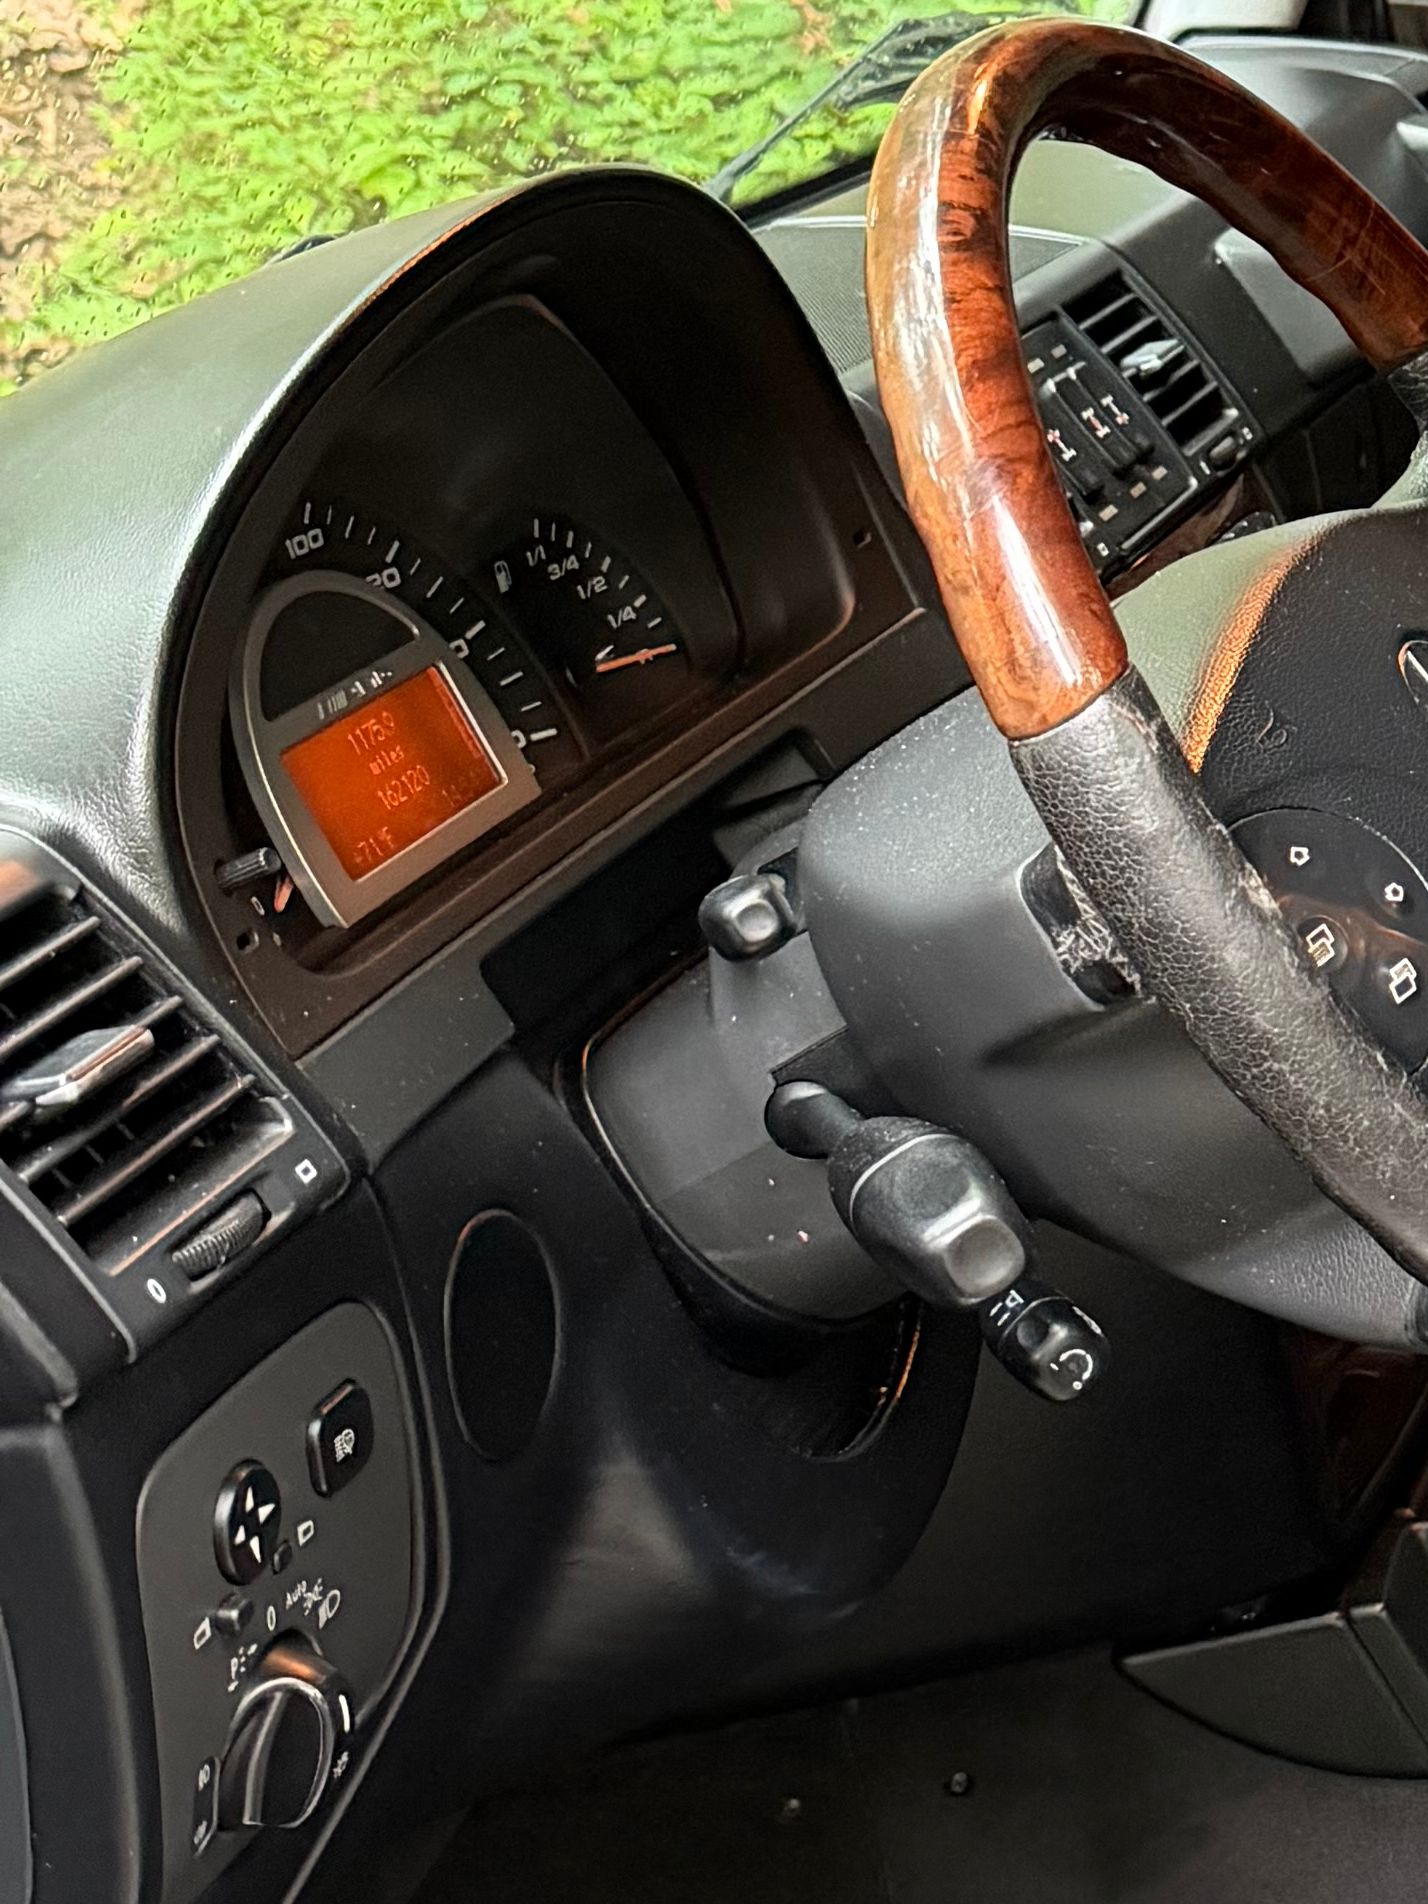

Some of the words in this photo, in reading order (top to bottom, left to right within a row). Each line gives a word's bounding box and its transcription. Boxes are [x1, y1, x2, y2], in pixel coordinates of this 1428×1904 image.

[284, 527, 325, 560] 100
[547, 554, 580, 581] 3/4
[576, 575, 609, 600] 1/2
[607, 605, 637, 630] 1/4
[368, 744, 405, 776] miles
[376, 764, 431, 811] 162120
